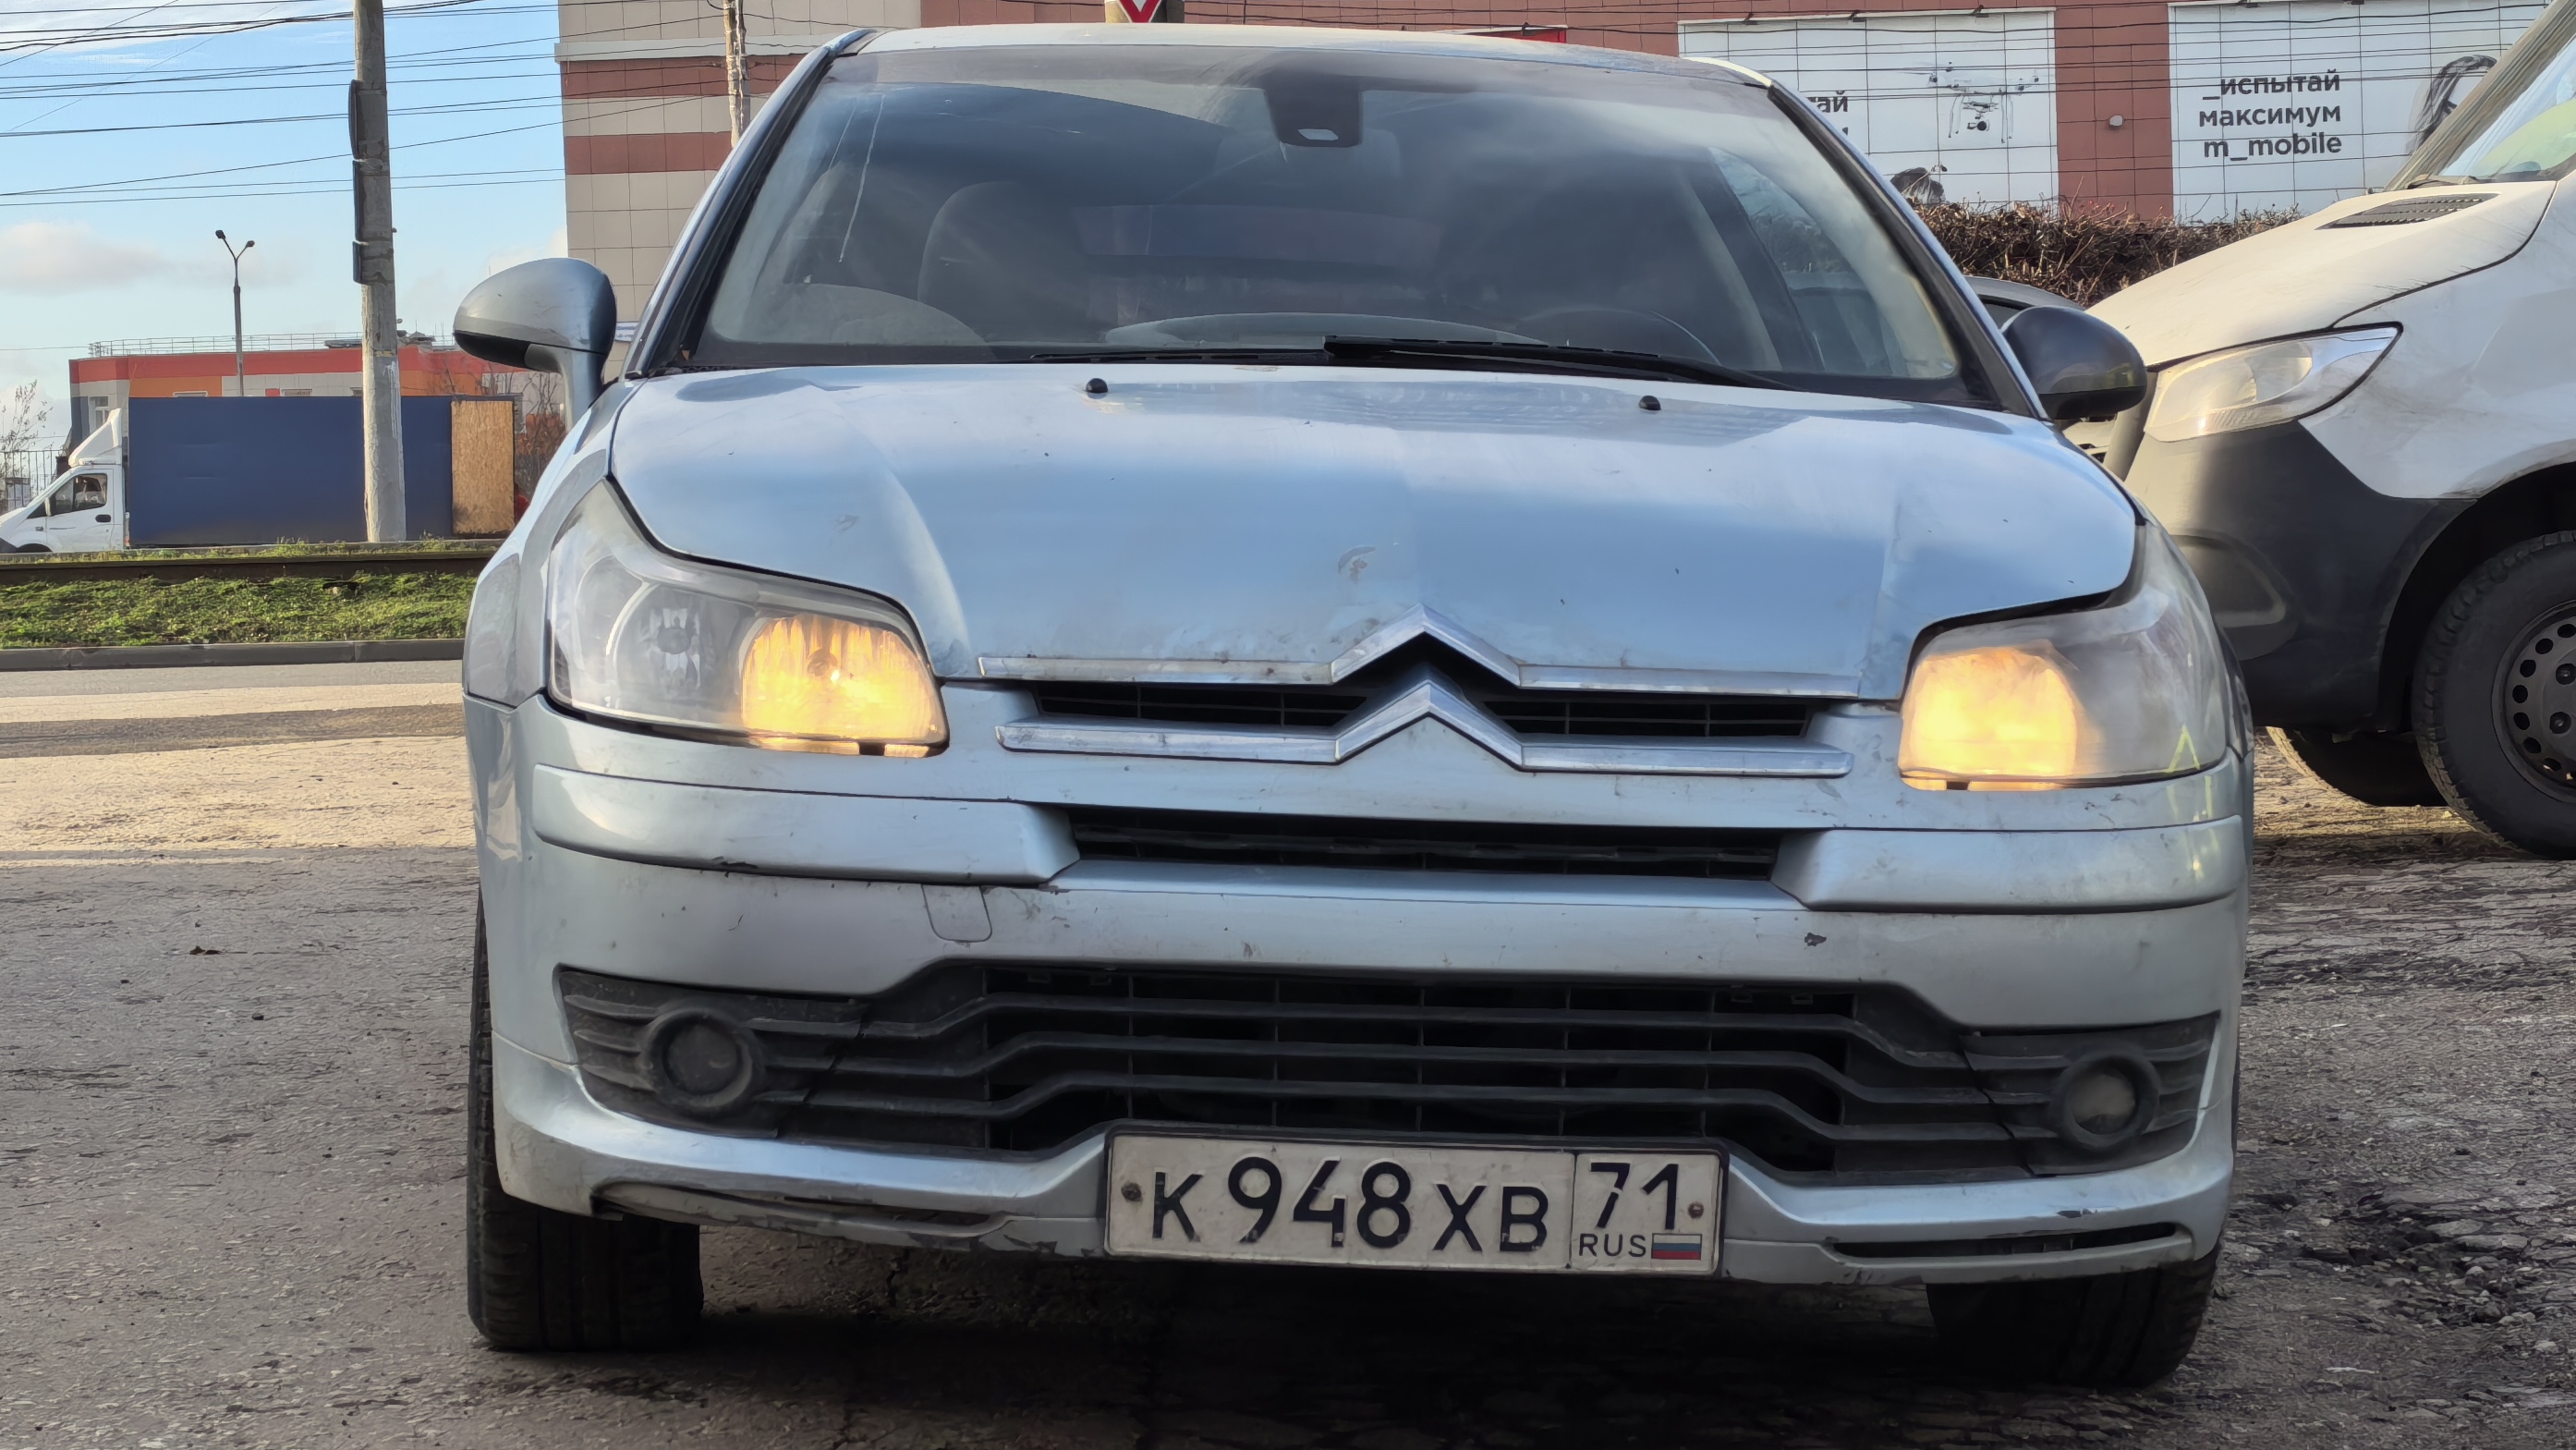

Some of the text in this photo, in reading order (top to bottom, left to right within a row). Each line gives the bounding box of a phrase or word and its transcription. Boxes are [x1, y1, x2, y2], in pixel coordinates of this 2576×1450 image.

[2199, 105, 2341, 128] максимум
[2204, 131, 2342, 161] m_mobile
[1589, 1161, 1680, 1231] 71
[1578, 1233, 1647, 1258] RUS
